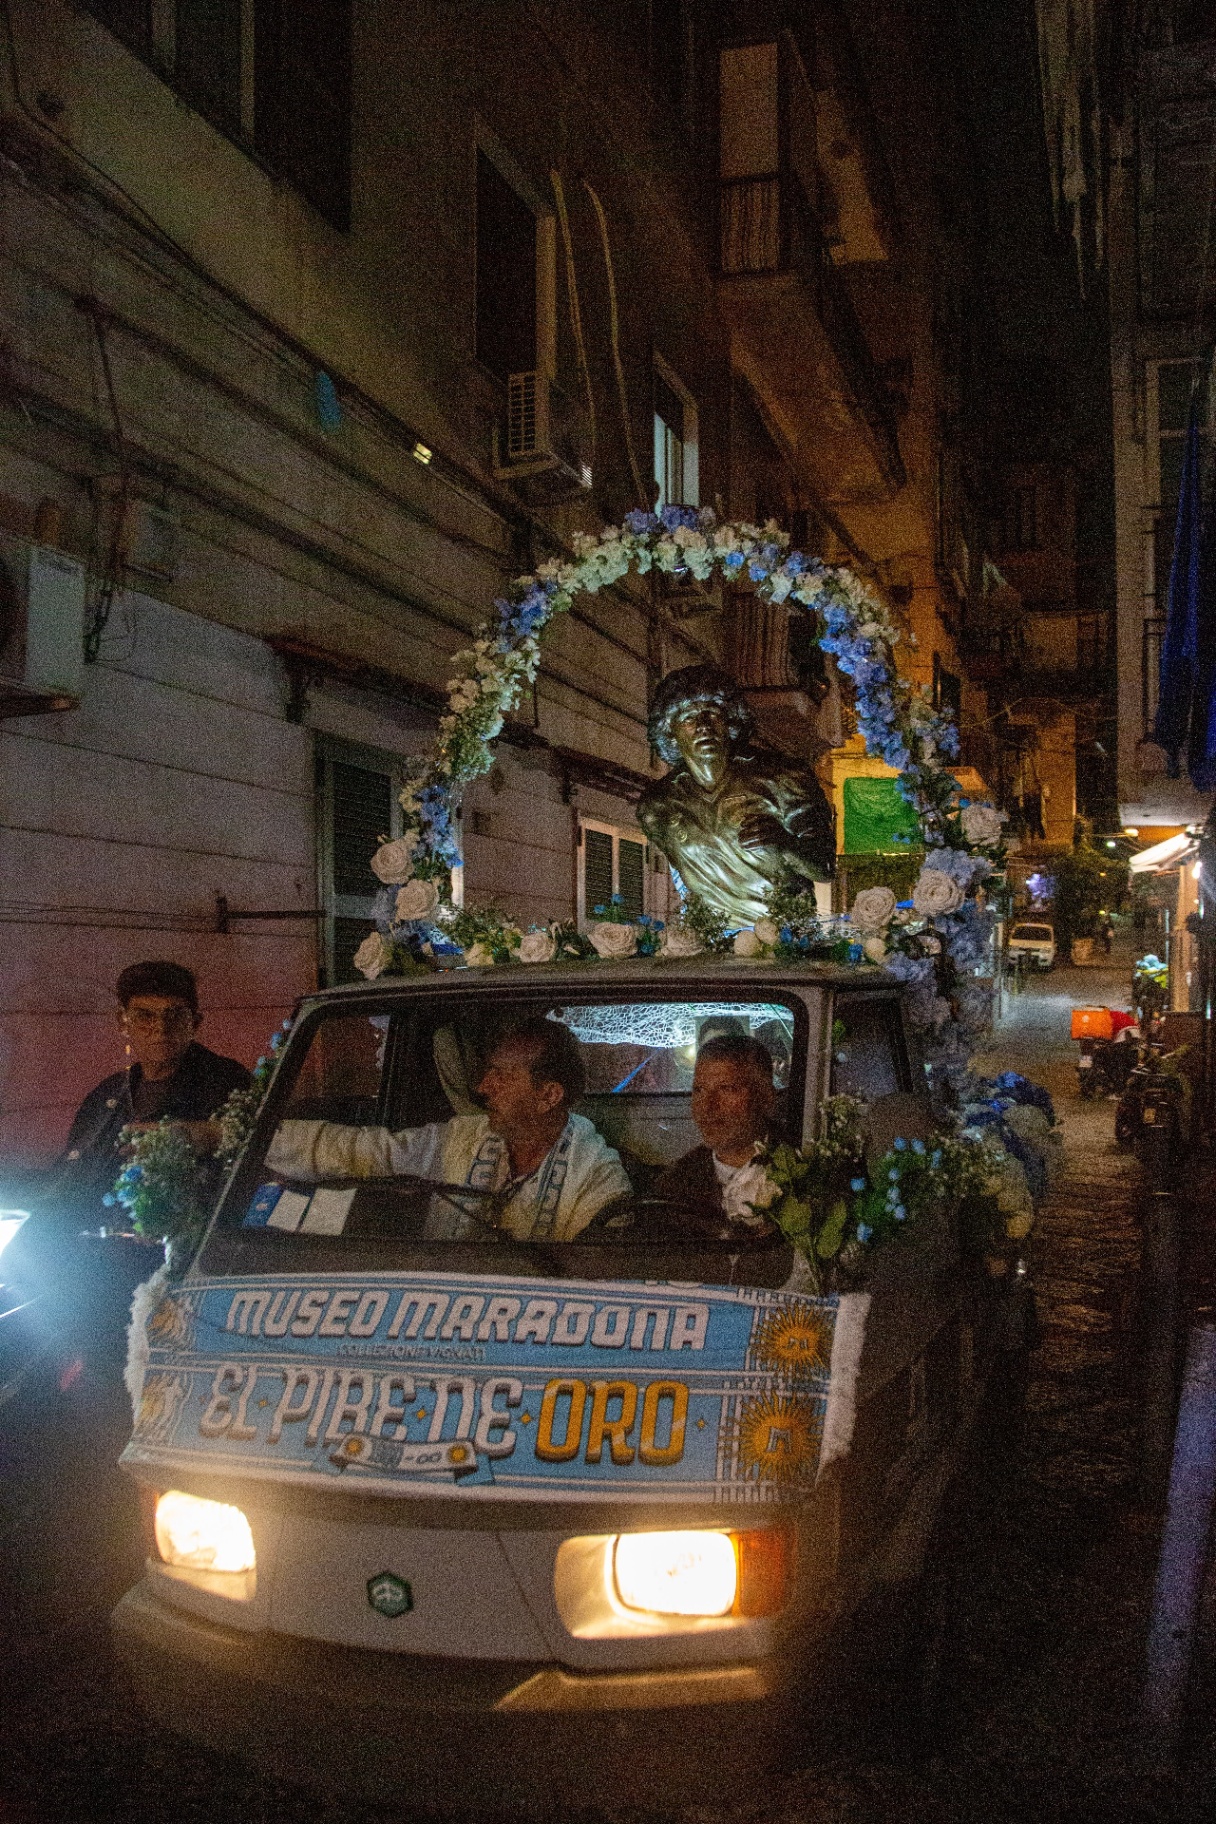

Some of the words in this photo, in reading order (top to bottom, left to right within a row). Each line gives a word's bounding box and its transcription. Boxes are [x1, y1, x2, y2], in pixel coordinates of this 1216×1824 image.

[226, 1290, 389, 1338] MUSEO
[387, 1291, 710, 1351] MARADONA
[200, 1363, 258, 1442] EL
[267, 1365, 420, 1450] PIBE
[535, 1377, 691, 1466] ORO
